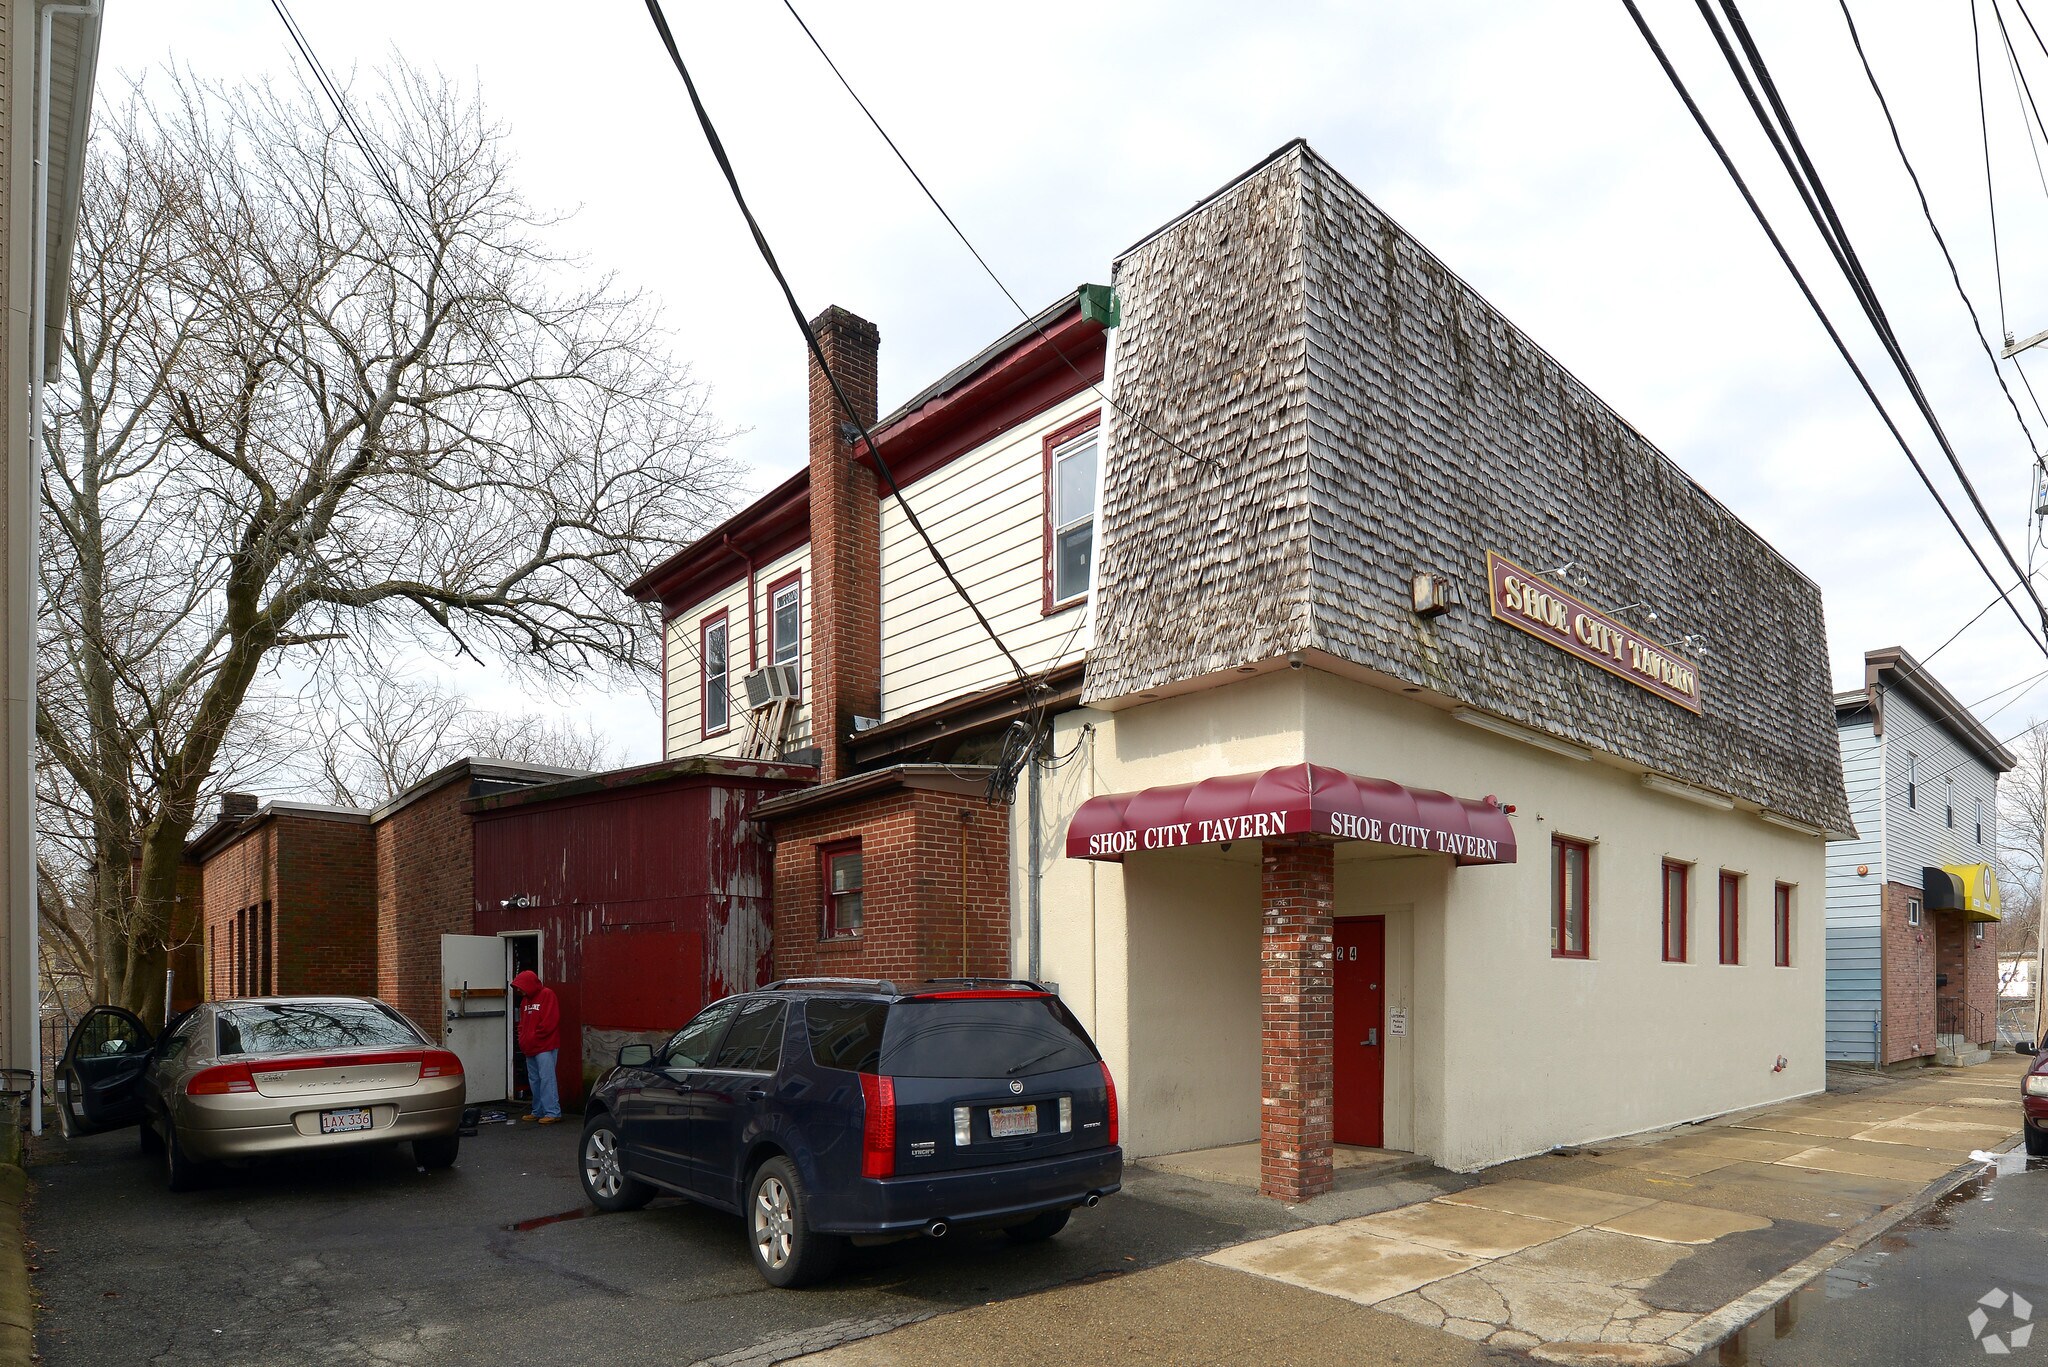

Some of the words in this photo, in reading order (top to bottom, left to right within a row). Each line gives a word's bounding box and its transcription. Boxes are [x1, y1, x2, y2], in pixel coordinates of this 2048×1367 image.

[1504, 576, 1571, 636] SHOE
[1575, 613, 1625, 662] CITY
[1628, 639, 1696, 698] TAVERN
[1089, 829, 1137, 855] SHOE
[1143, 822, 1192, 849] CITY
[1198, 810, 1288, 844] TAVERN
[1330, 811, 1382, 843] SHOE
[1388, 821, 1430, 851] CITY
[1436, 831, 1498, 860] TAVERN
[323, 1115, 345, 1128] 1AX
[348, 1113, 369, 1126] 336
